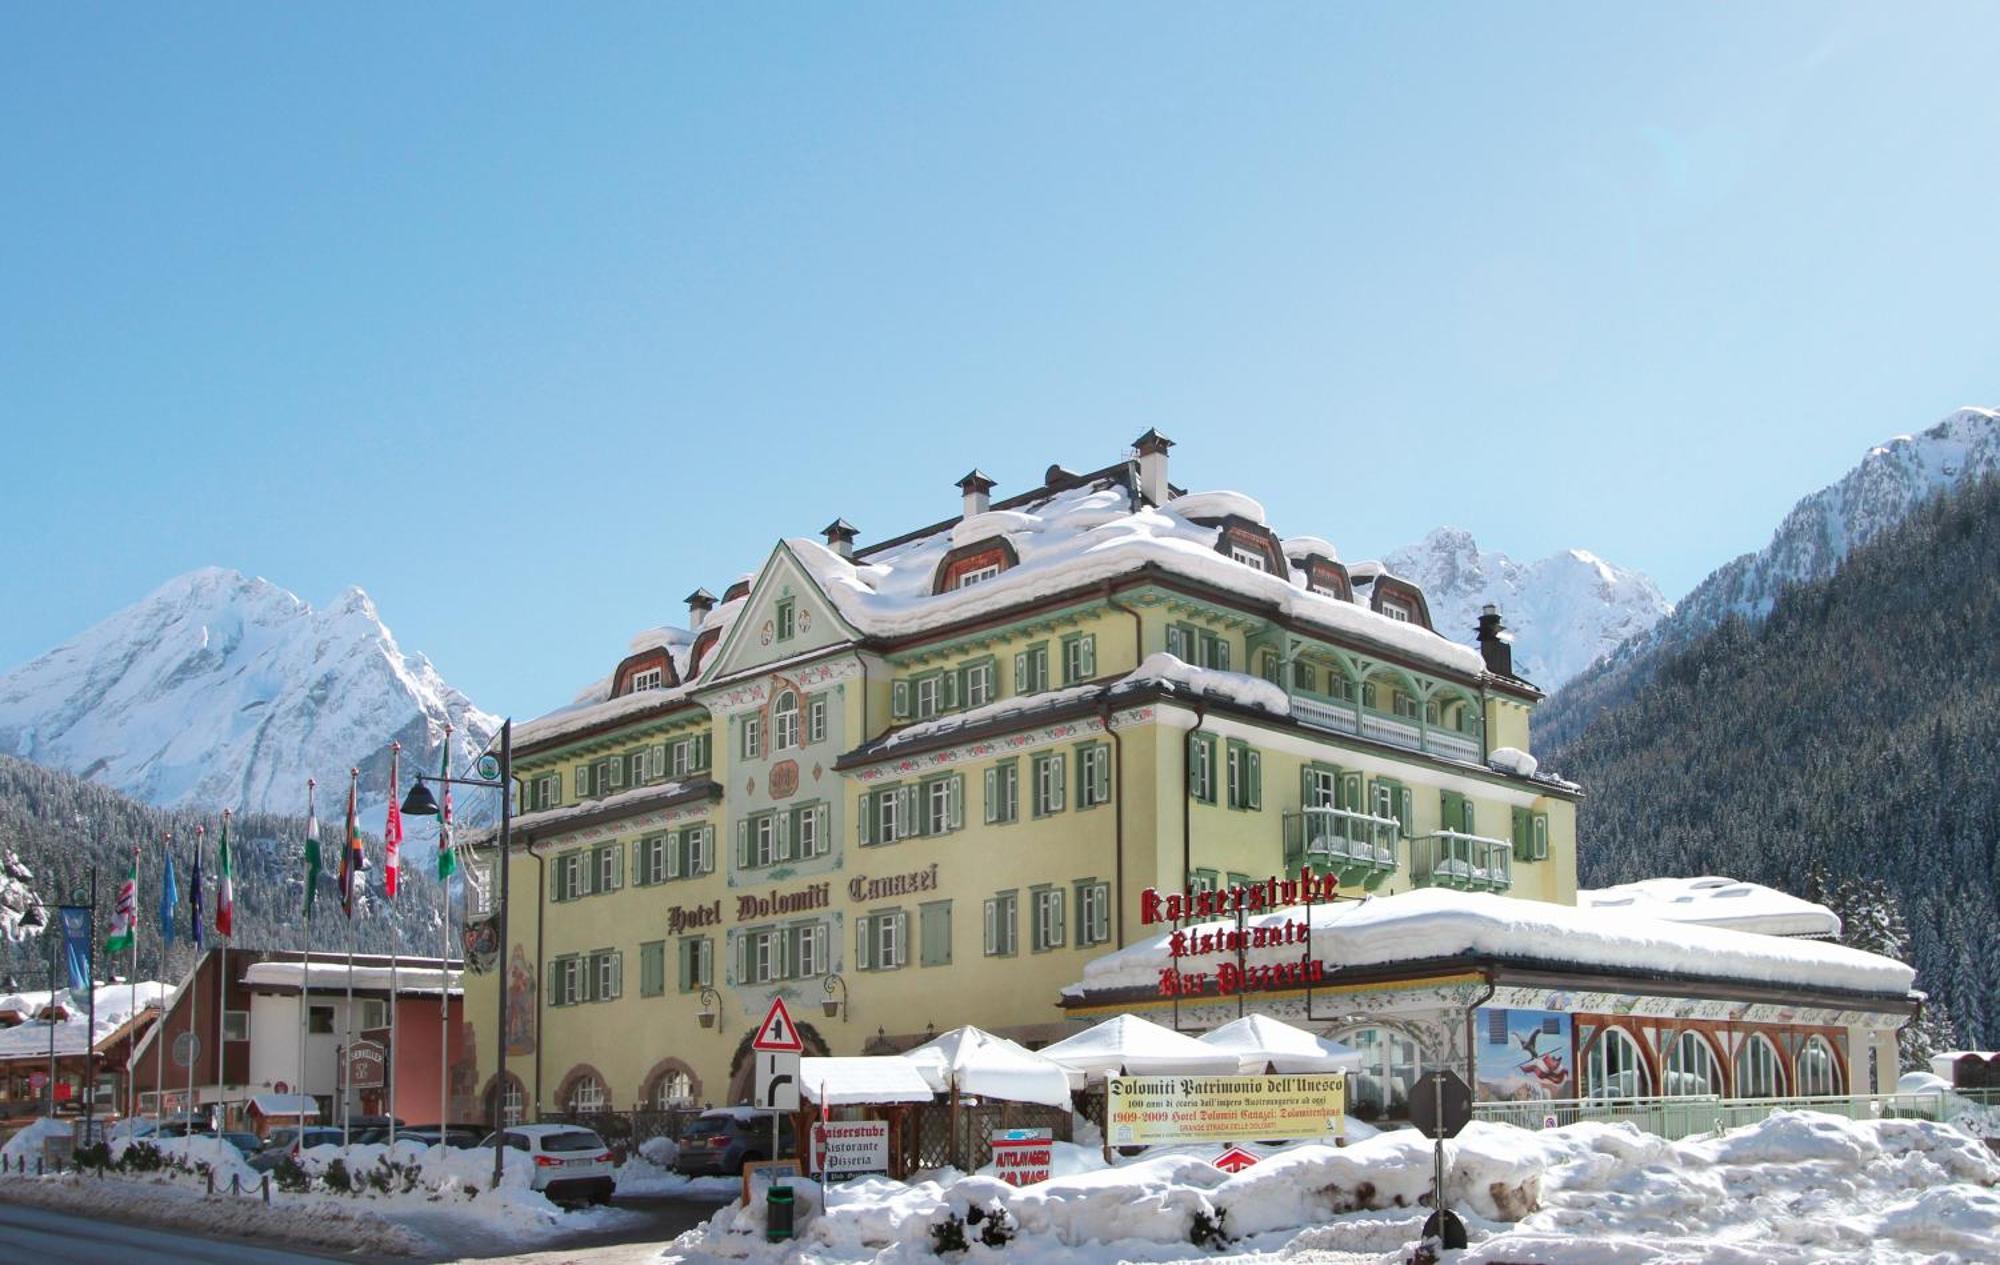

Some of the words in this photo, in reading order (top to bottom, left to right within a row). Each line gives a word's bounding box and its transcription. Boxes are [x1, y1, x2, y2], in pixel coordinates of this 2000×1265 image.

[667, 899, 722, 936] Hotel
[736, 882, 831, 921] Dolomiti
[848, 863, 939, 902] Canazei
[1141, 865, 1338, 925] Kaiserstube
[1168, 918, 1311, 958] Ristorante
[1158, 966, 1207, 997] Bar
[1216, 952, 1324, 995] Pizzeria
[1110, 1079, 1176, 1096] Dolomiti
[1180, 1078, 1262, 1098] Patrimonio
[1267, 1077, 1343, 1093] dell'Unesco
[1113, 1111, 1169, 1123] 1909-2009
[1171, 1110, 1197, 1122] Hotel
[1128, 1100, 1144, 1109] 100
[829, 1155, 872, 1168] Pizzeria
